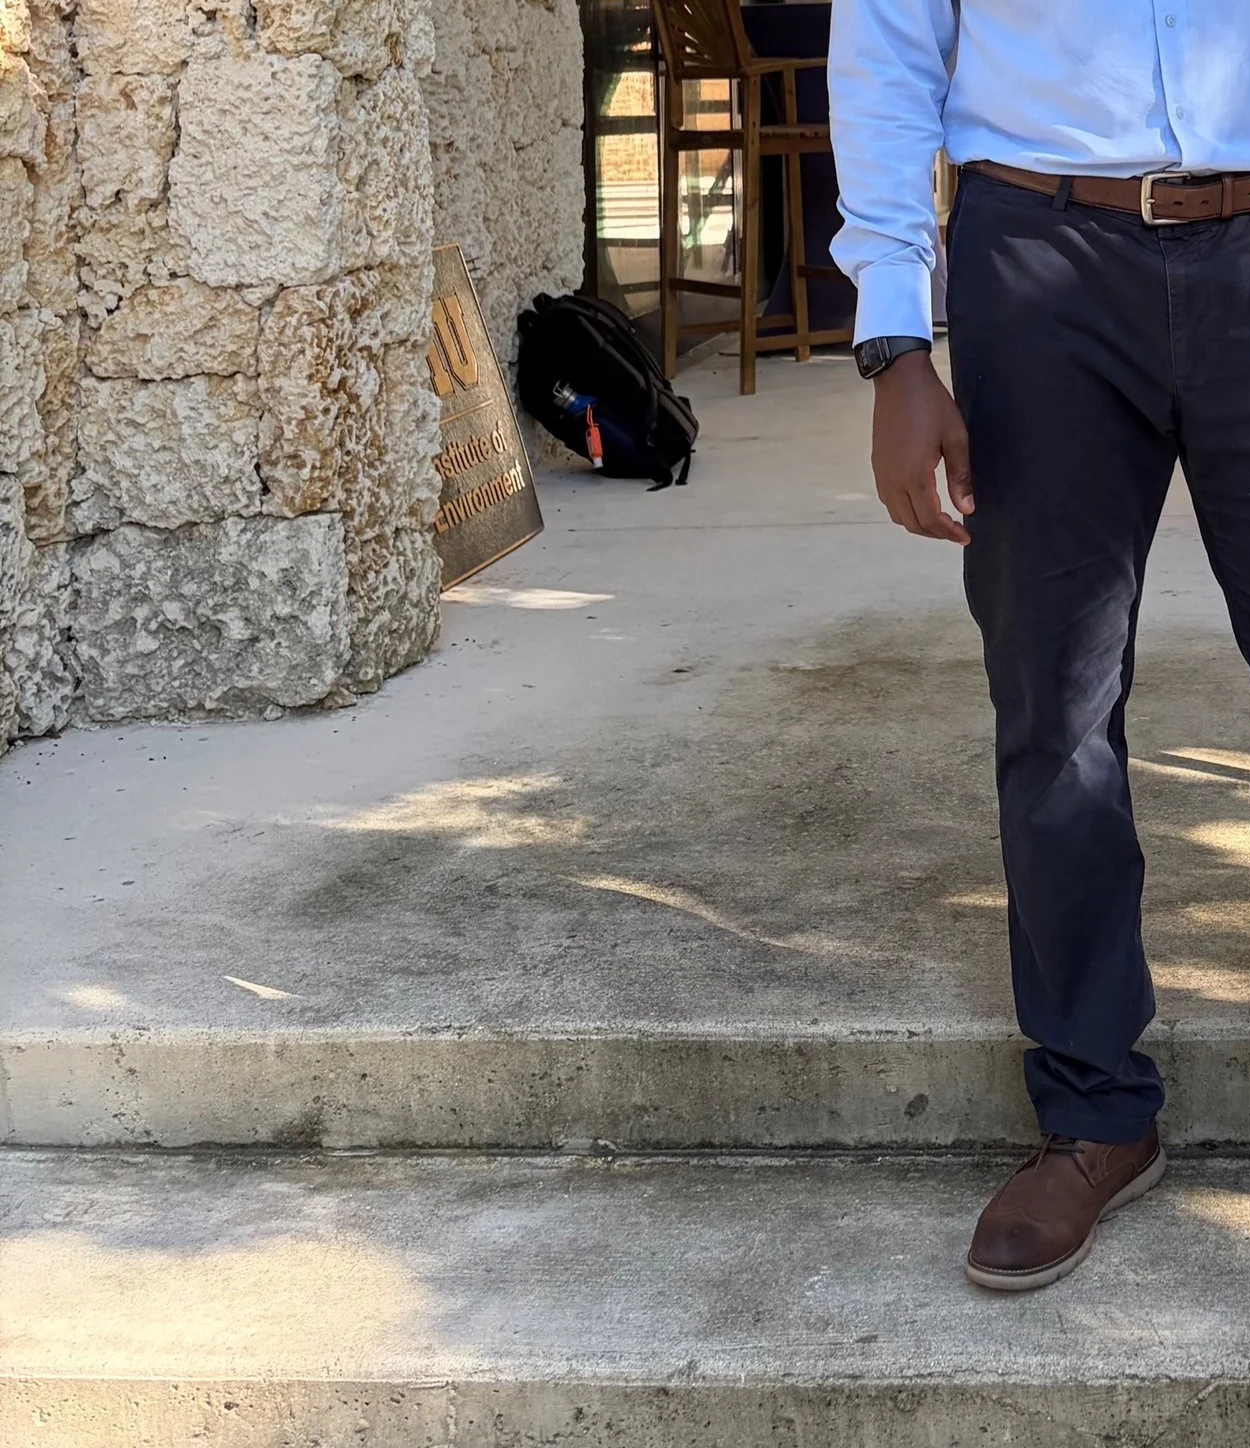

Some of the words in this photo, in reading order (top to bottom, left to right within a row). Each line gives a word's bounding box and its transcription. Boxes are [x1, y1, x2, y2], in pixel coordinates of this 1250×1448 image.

[426, 294, 479, 397] IU
[432, 434, 489, 481] nstitute
[491, 420, 508, 454] of
